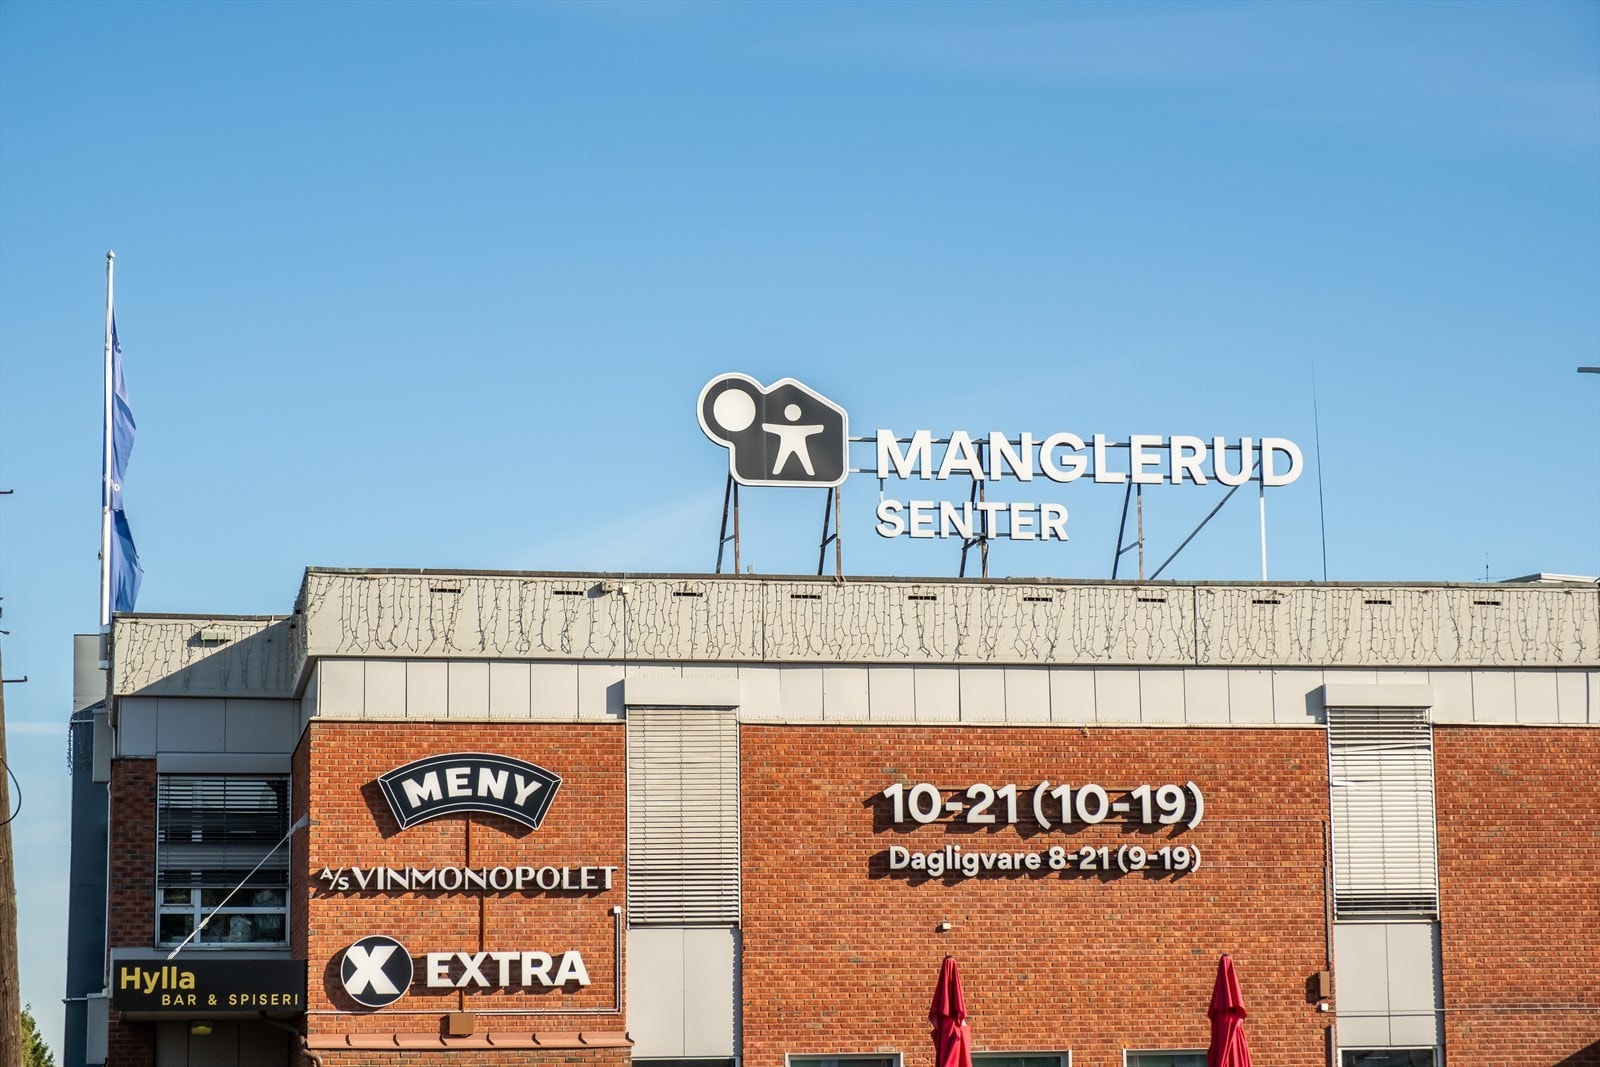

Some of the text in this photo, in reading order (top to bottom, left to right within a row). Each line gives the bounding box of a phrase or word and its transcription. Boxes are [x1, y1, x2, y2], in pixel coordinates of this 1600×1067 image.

[876, 429, 1304, 486] MANGLERUD
[876, 499, 1069, 541] SENTER
[401, 767, 542, 809] MENY
[883, 780, 1205, 830] 10-21 (10-19)
[351, 866, 618, 890] VINMONOPOLET
[889, 844, 1201, 877] Dagligvare 8-21 (9-19)
[120, 966, 196, 994] Hylla
[426, 950, 591, 988] EXTRA
[161, 993, 299, 1006] BAR & SPISERI
